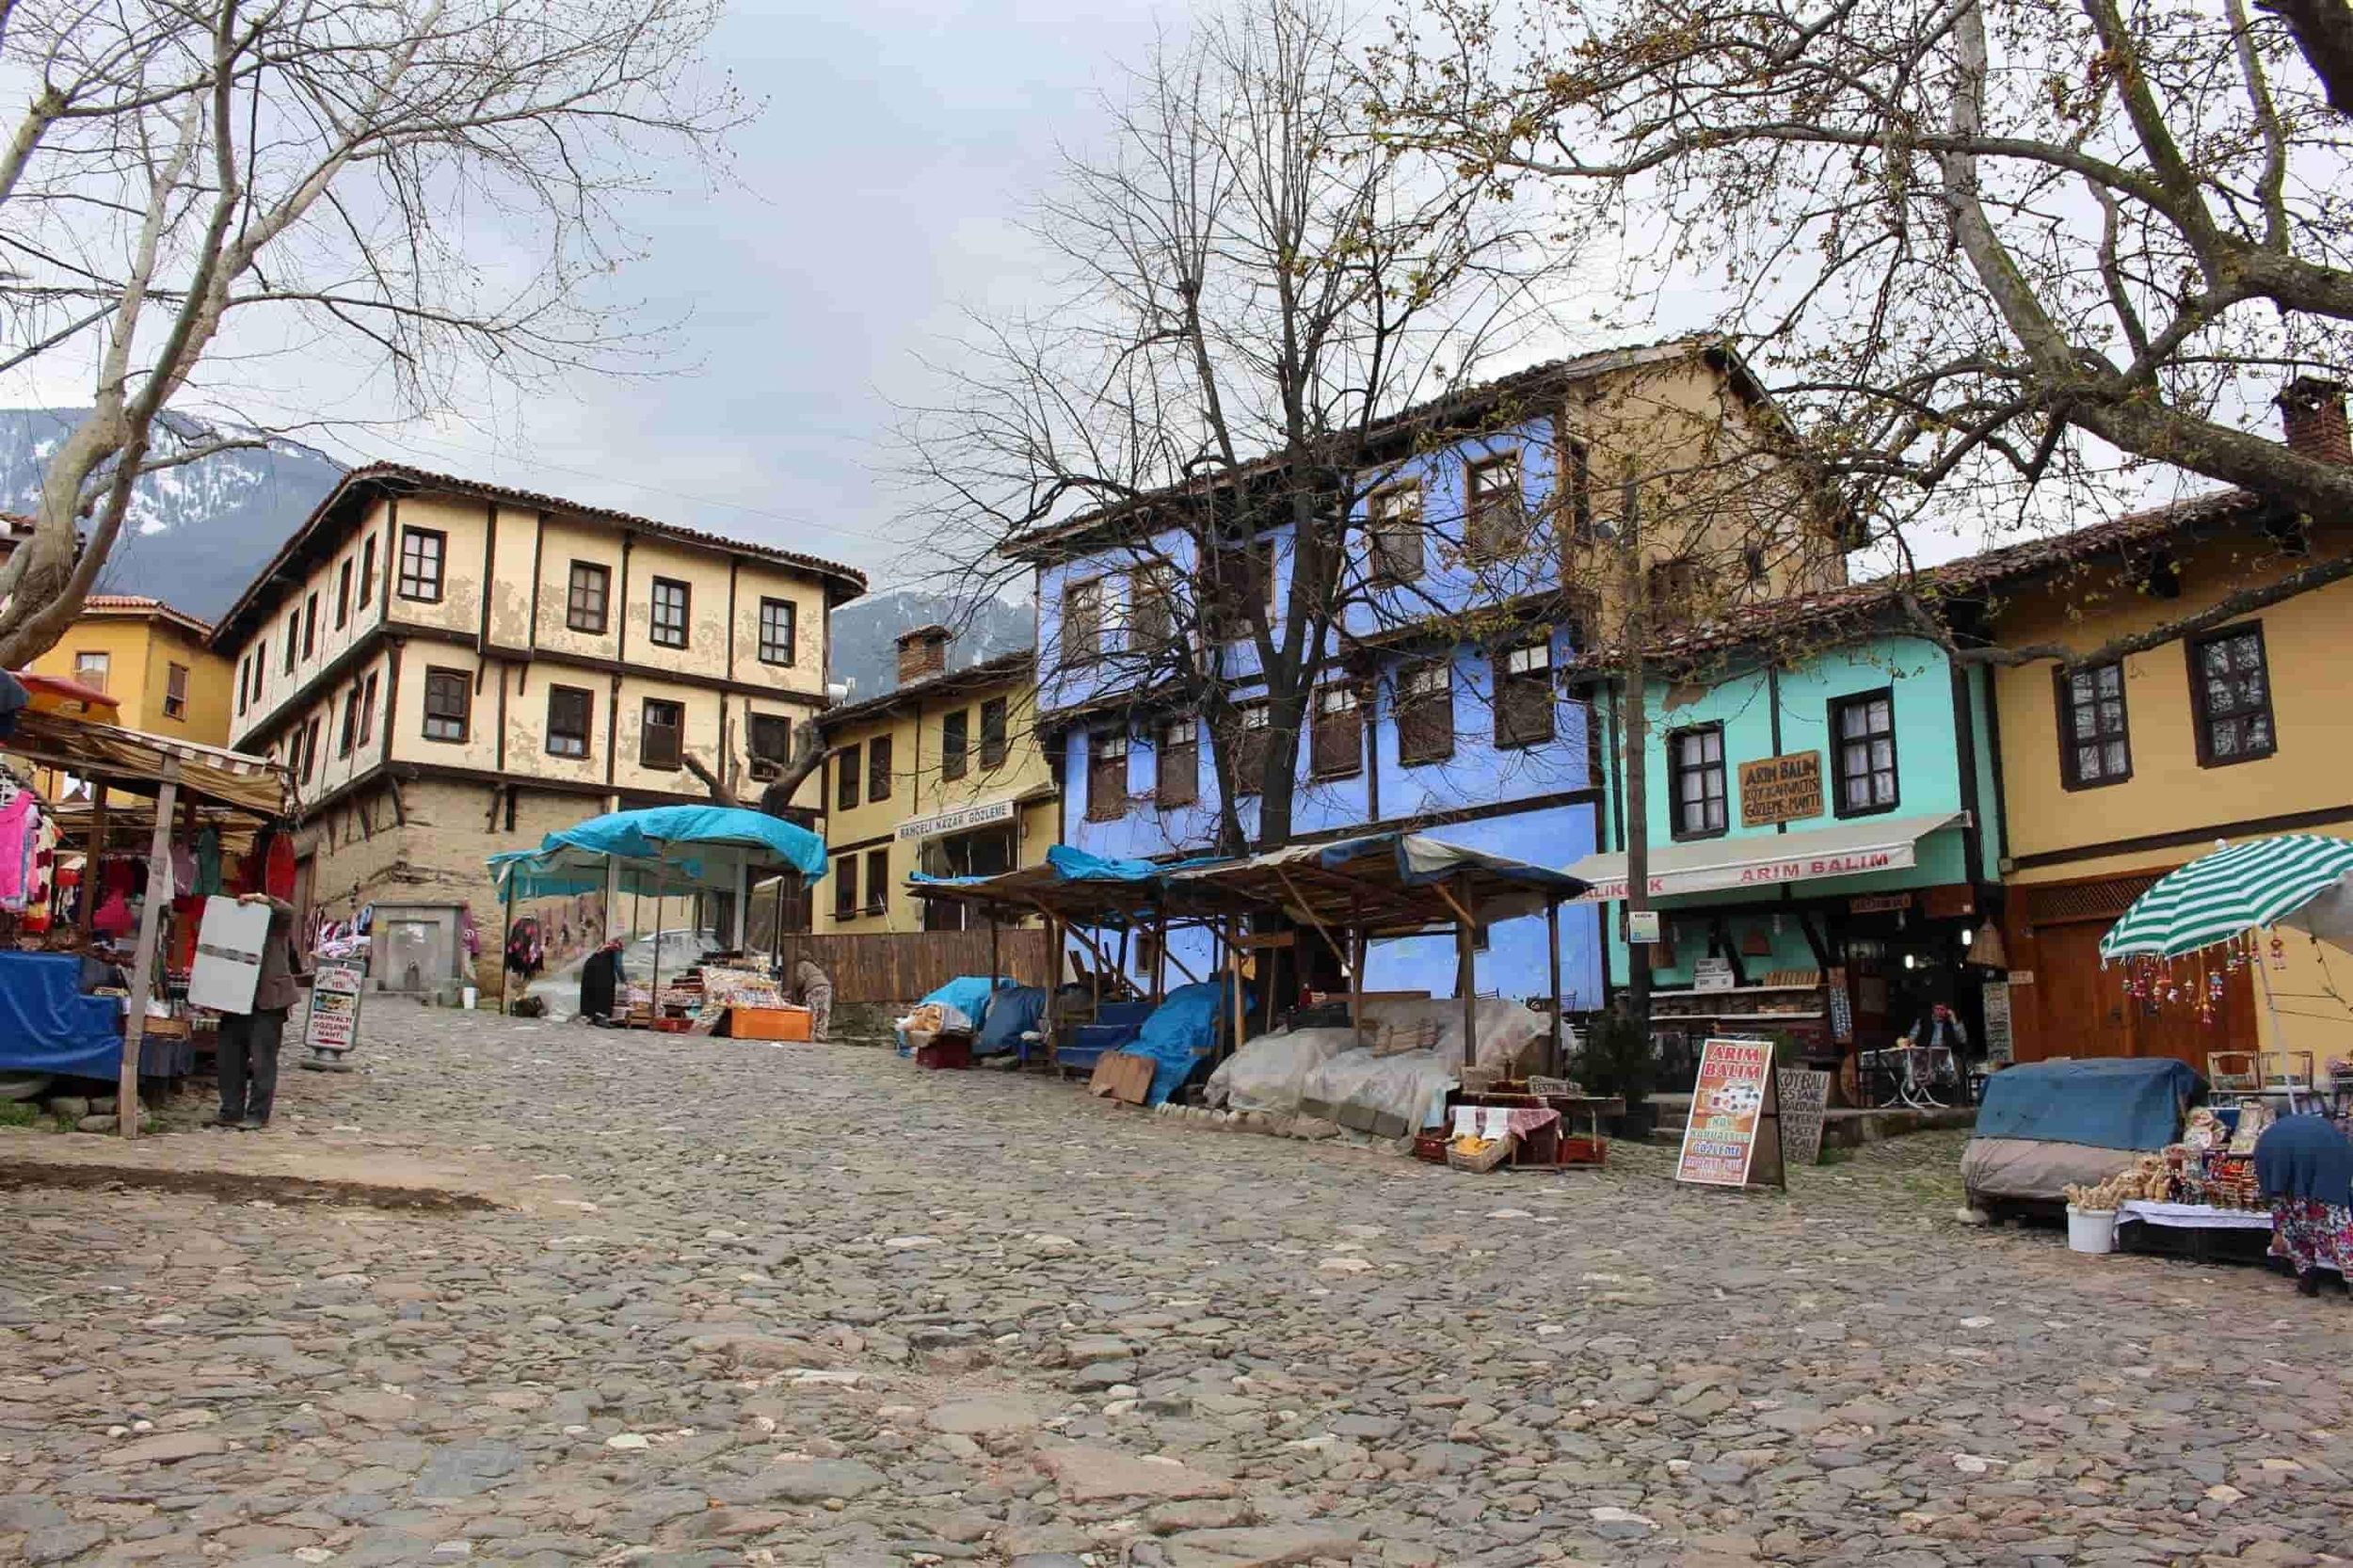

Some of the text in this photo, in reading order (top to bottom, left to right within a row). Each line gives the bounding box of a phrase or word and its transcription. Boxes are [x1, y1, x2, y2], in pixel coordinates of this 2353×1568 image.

[1741, 853, 1889, 883] ARIM BALIM
[1710, 1045, 1760, 1062] ARIM
[1704, 1061, 1762, 1079] BALIM
